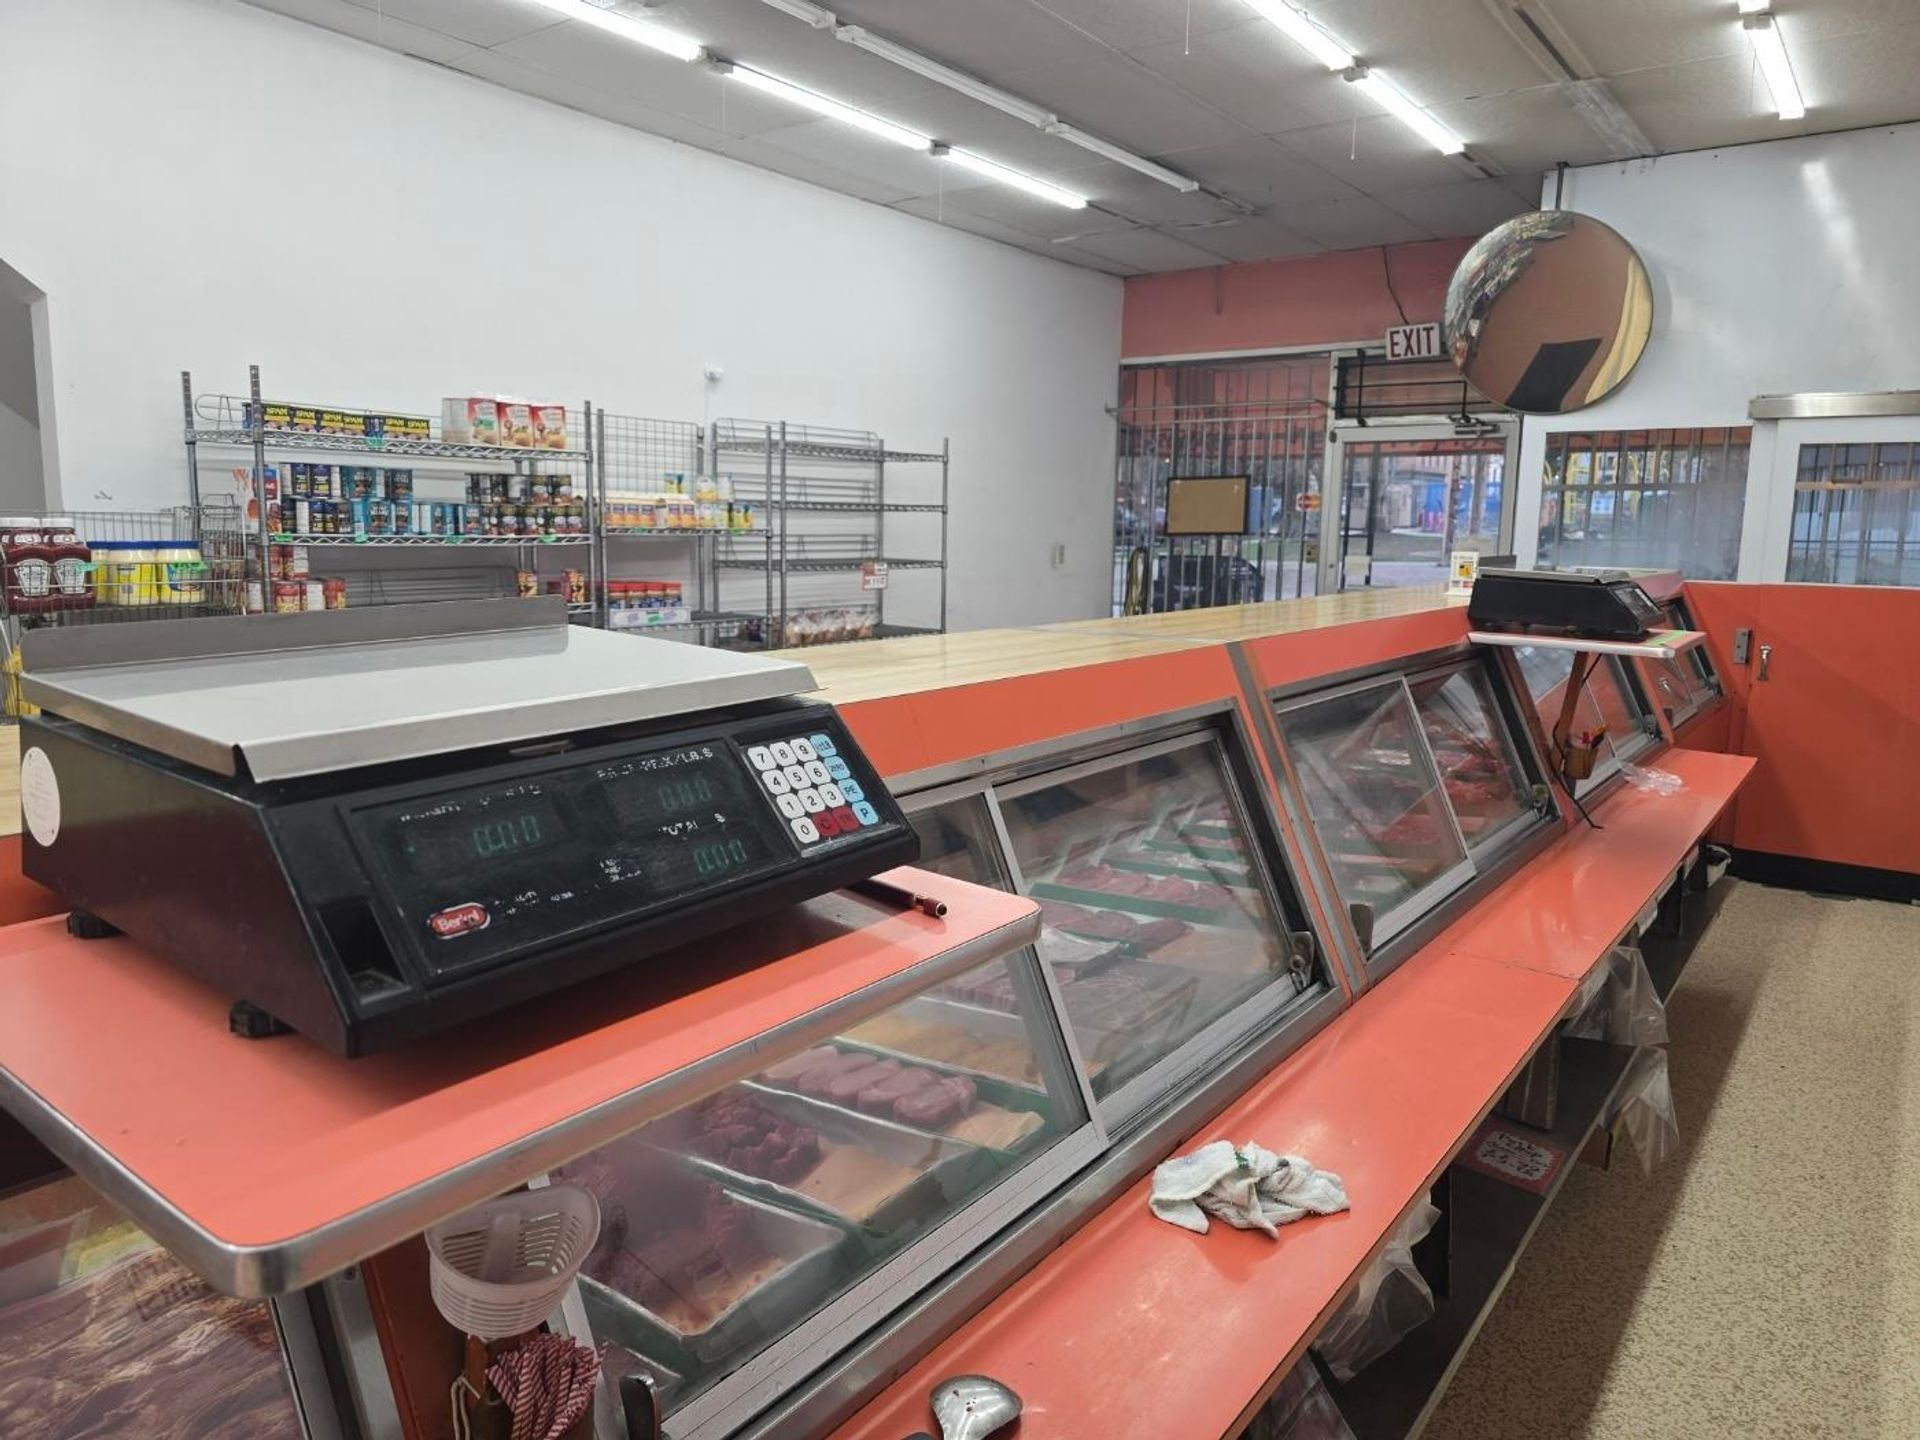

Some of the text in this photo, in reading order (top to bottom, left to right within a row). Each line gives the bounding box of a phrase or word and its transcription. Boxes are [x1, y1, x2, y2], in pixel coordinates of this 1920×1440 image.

[1390, 326, 1434, 358] EXIT
[757, 752, 765, 764] 7
[779, 749, 789, 760] 8
[799, 745, 809, 755] 9
[773, 776, 782, 787] 4
[792, 771, 802, 782] 5
[812, 767, 823, 778] 6
[786, 800, 795, 811] 1
[806, 795, 818, 807] 2
[826, 790, 838, 801] 3
[799, 823, 811, 836] 0
[859, 807, 869, 818] P
